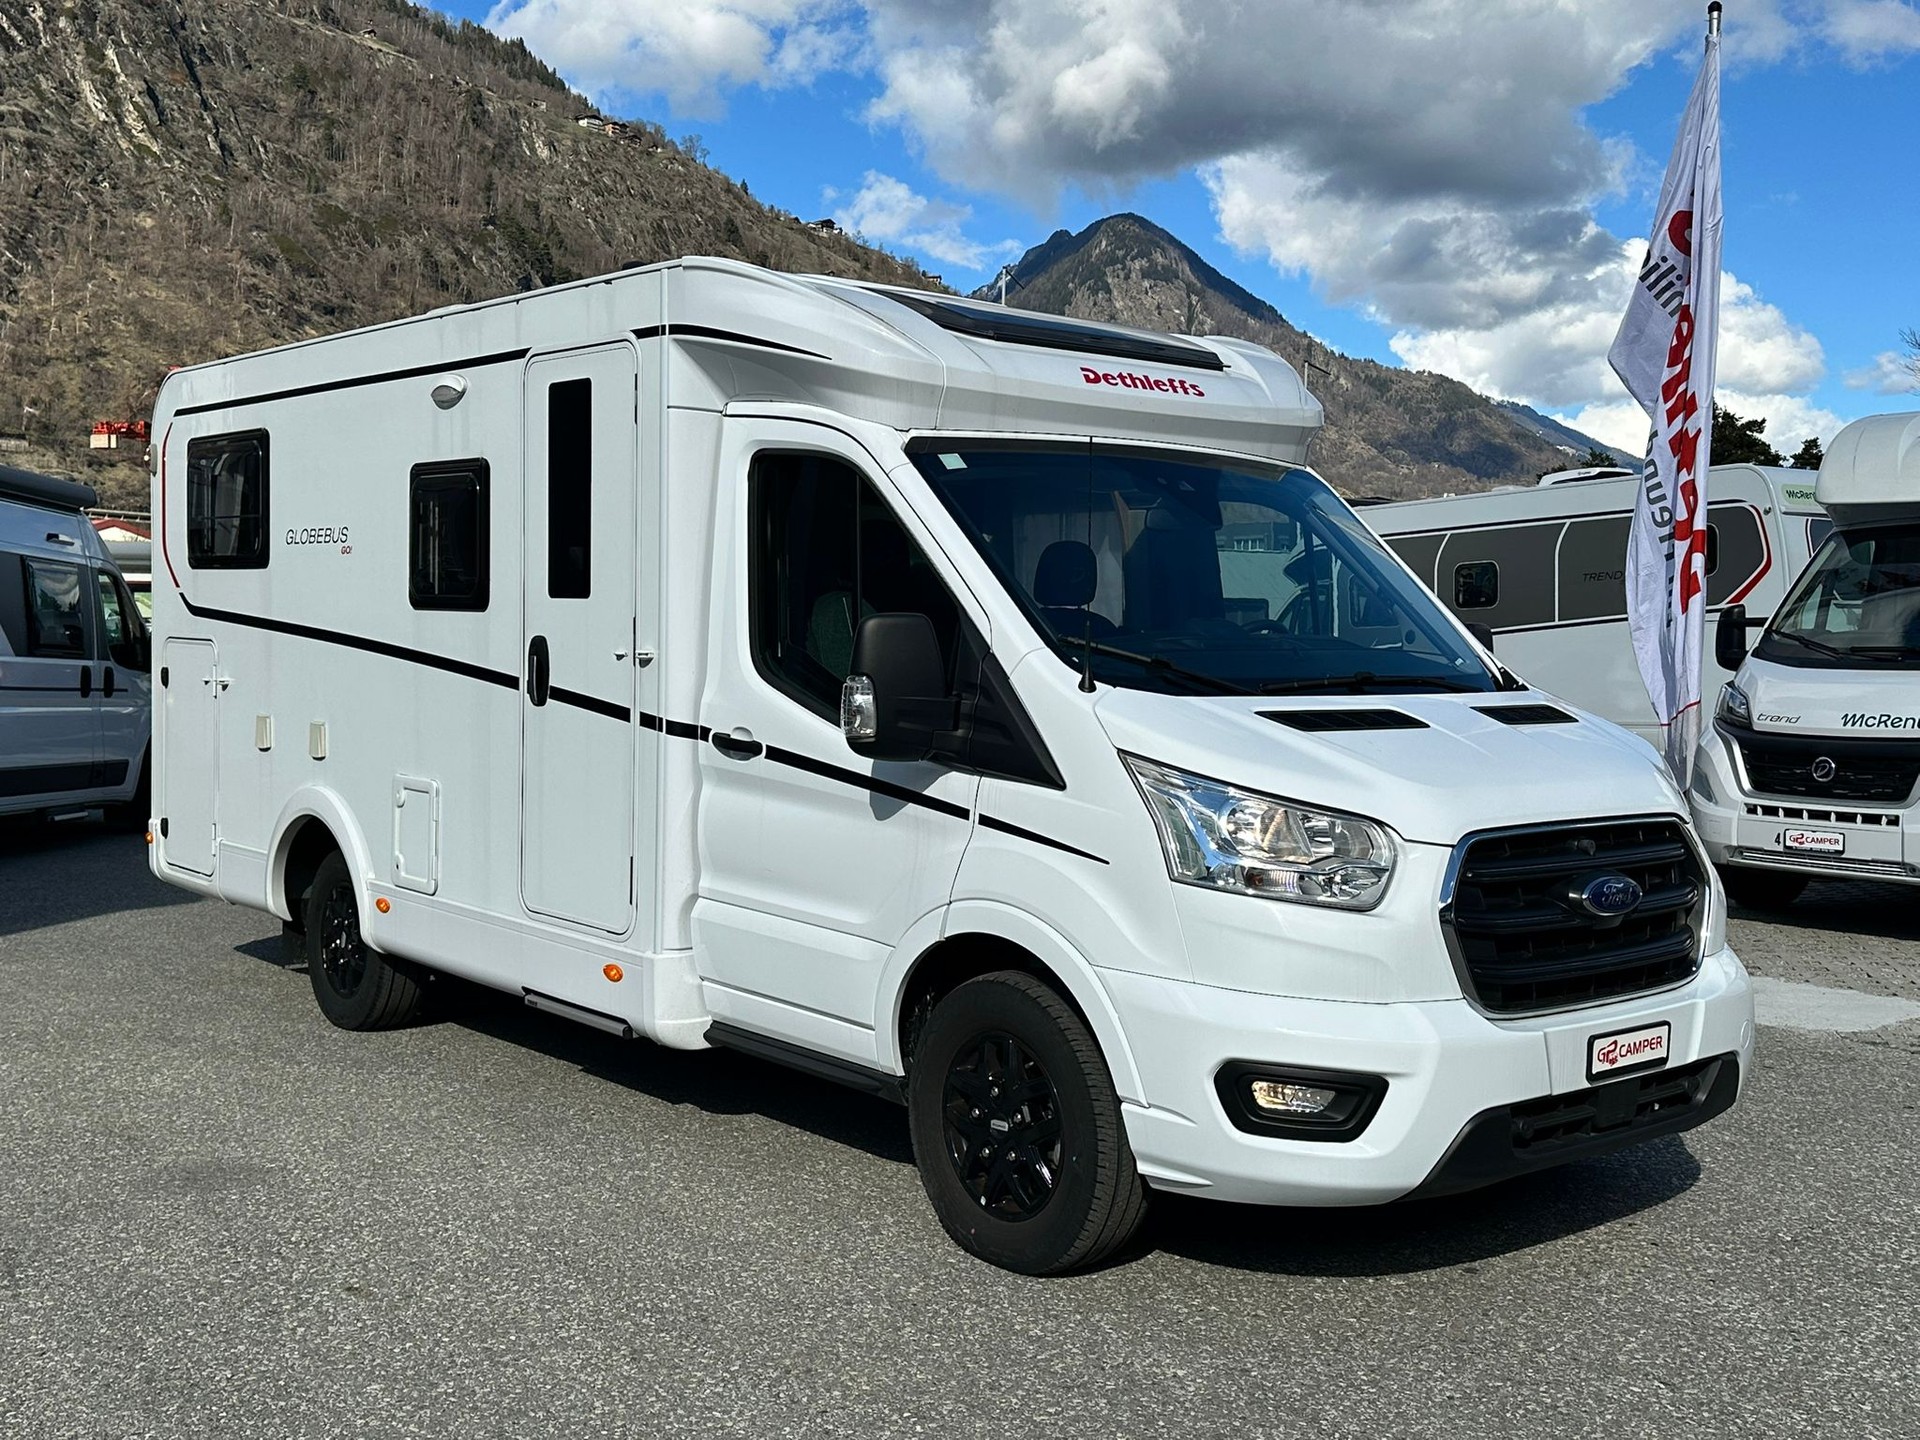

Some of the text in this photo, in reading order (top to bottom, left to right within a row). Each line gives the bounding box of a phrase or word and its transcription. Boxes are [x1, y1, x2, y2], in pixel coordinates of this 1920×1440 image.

[1080, 367, 1205, 397] Dethleffs
[285, 526, 349, 545] GLOBEBUS
[1582, 570, 1623, 583] TREND
[1757, 712, 1801, 724] trend
[1774, 832, 1781, 846] 4
[1805, 836, 1840, 846] CAMPER
[1602, 882, 1633, 905] Ford
[1618, 1035, 1663, 1058] CAMPER
